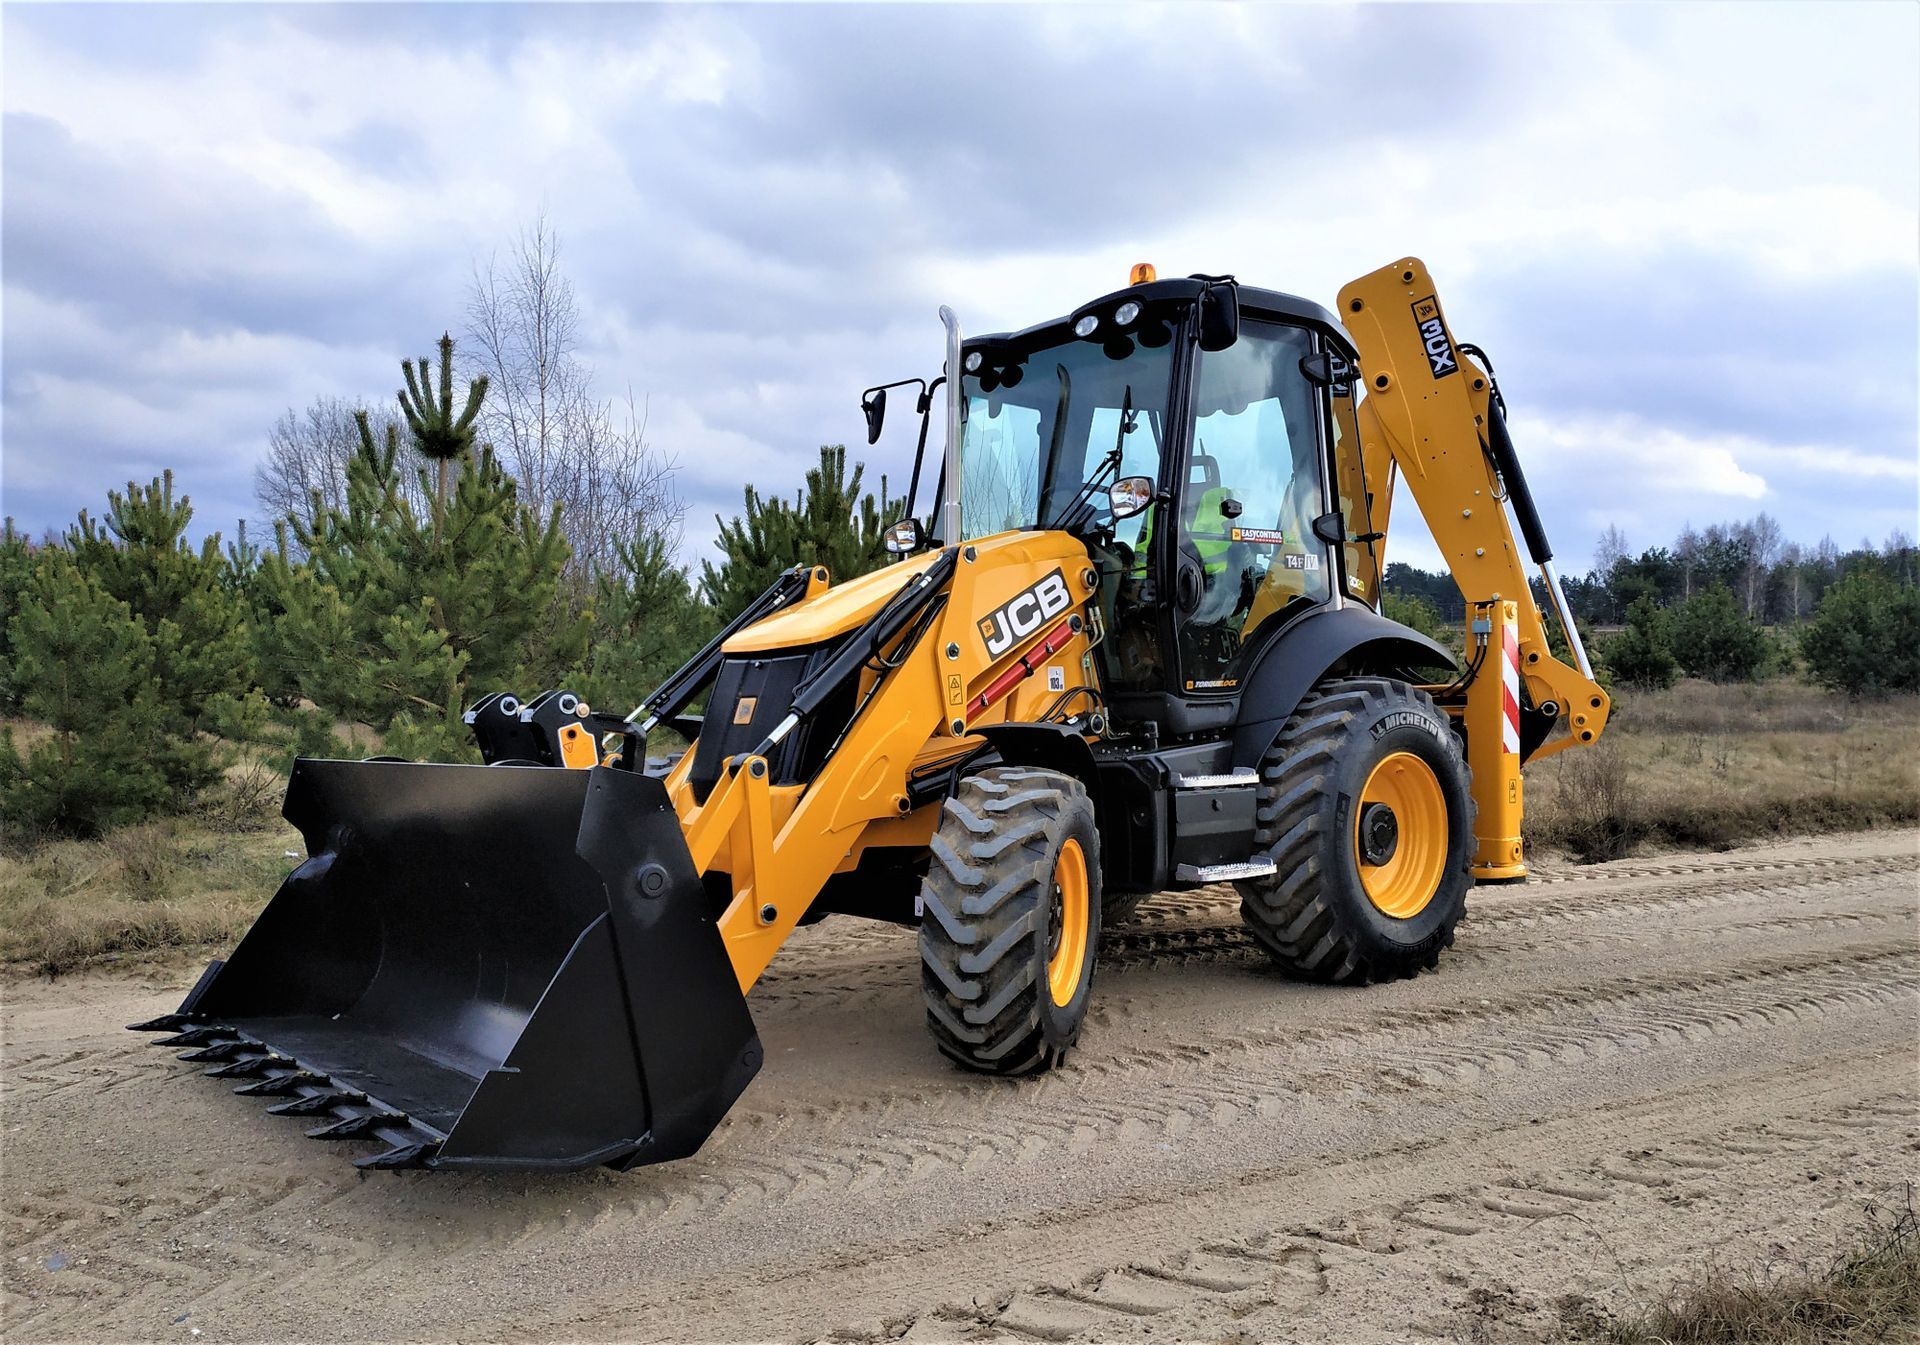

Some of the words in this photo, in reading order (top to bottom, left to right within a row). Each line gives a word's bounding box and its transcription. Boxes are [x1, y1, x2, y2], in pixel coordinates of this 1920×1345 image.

[1421, 318, 1456, 372] 3CX
[1241, 529, 1282, 539] EASYCONTROL
[1285, 555, 1304, 569] T4F
[987, 574, 1070, 655] JCB
[1384, 712, 1438, 736] MICHELIN
